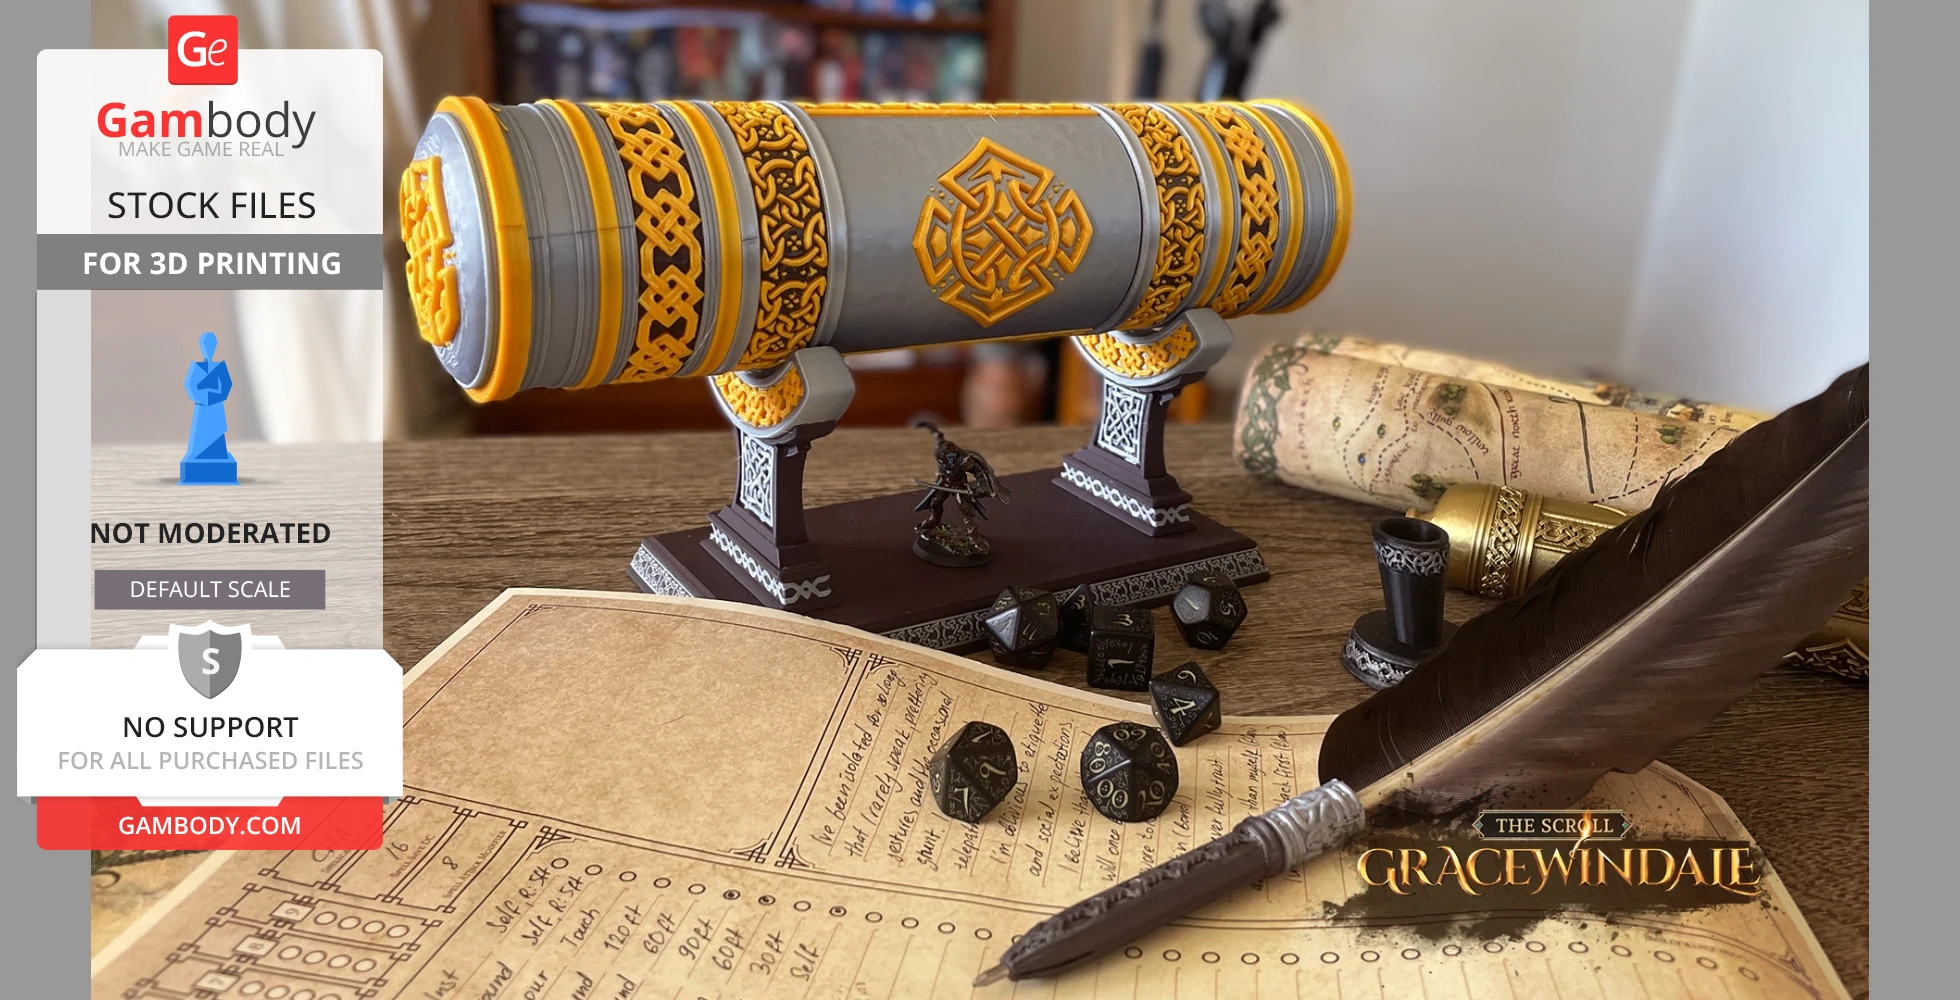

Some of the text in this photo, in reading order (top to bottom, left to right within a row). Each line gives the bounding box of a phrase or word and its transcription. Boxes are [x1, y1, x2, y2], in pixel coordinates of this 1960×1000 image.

[1170, 697, 1197, 716] 4
[825, 780, 850, 821] been
[954, 787, 969, 815] 7
[1097, 778, 1128, 809] 00
[1138, 780, 1166, 812] 20
[844, 826, 869, 858] that
[869, 773, 903, 818] rarely
[385, 842, 409, 861] 16
[952, 819, 981, 870] telepath
[1025, 844, 1042, 877] and
[1139, 840, 1156, 876] wore
[442, 855, 458, 870] 8
[560, 908, 600, 948] Touch
[790, 943, 821, 981] Self
[523, 970, 549, 1000] our
